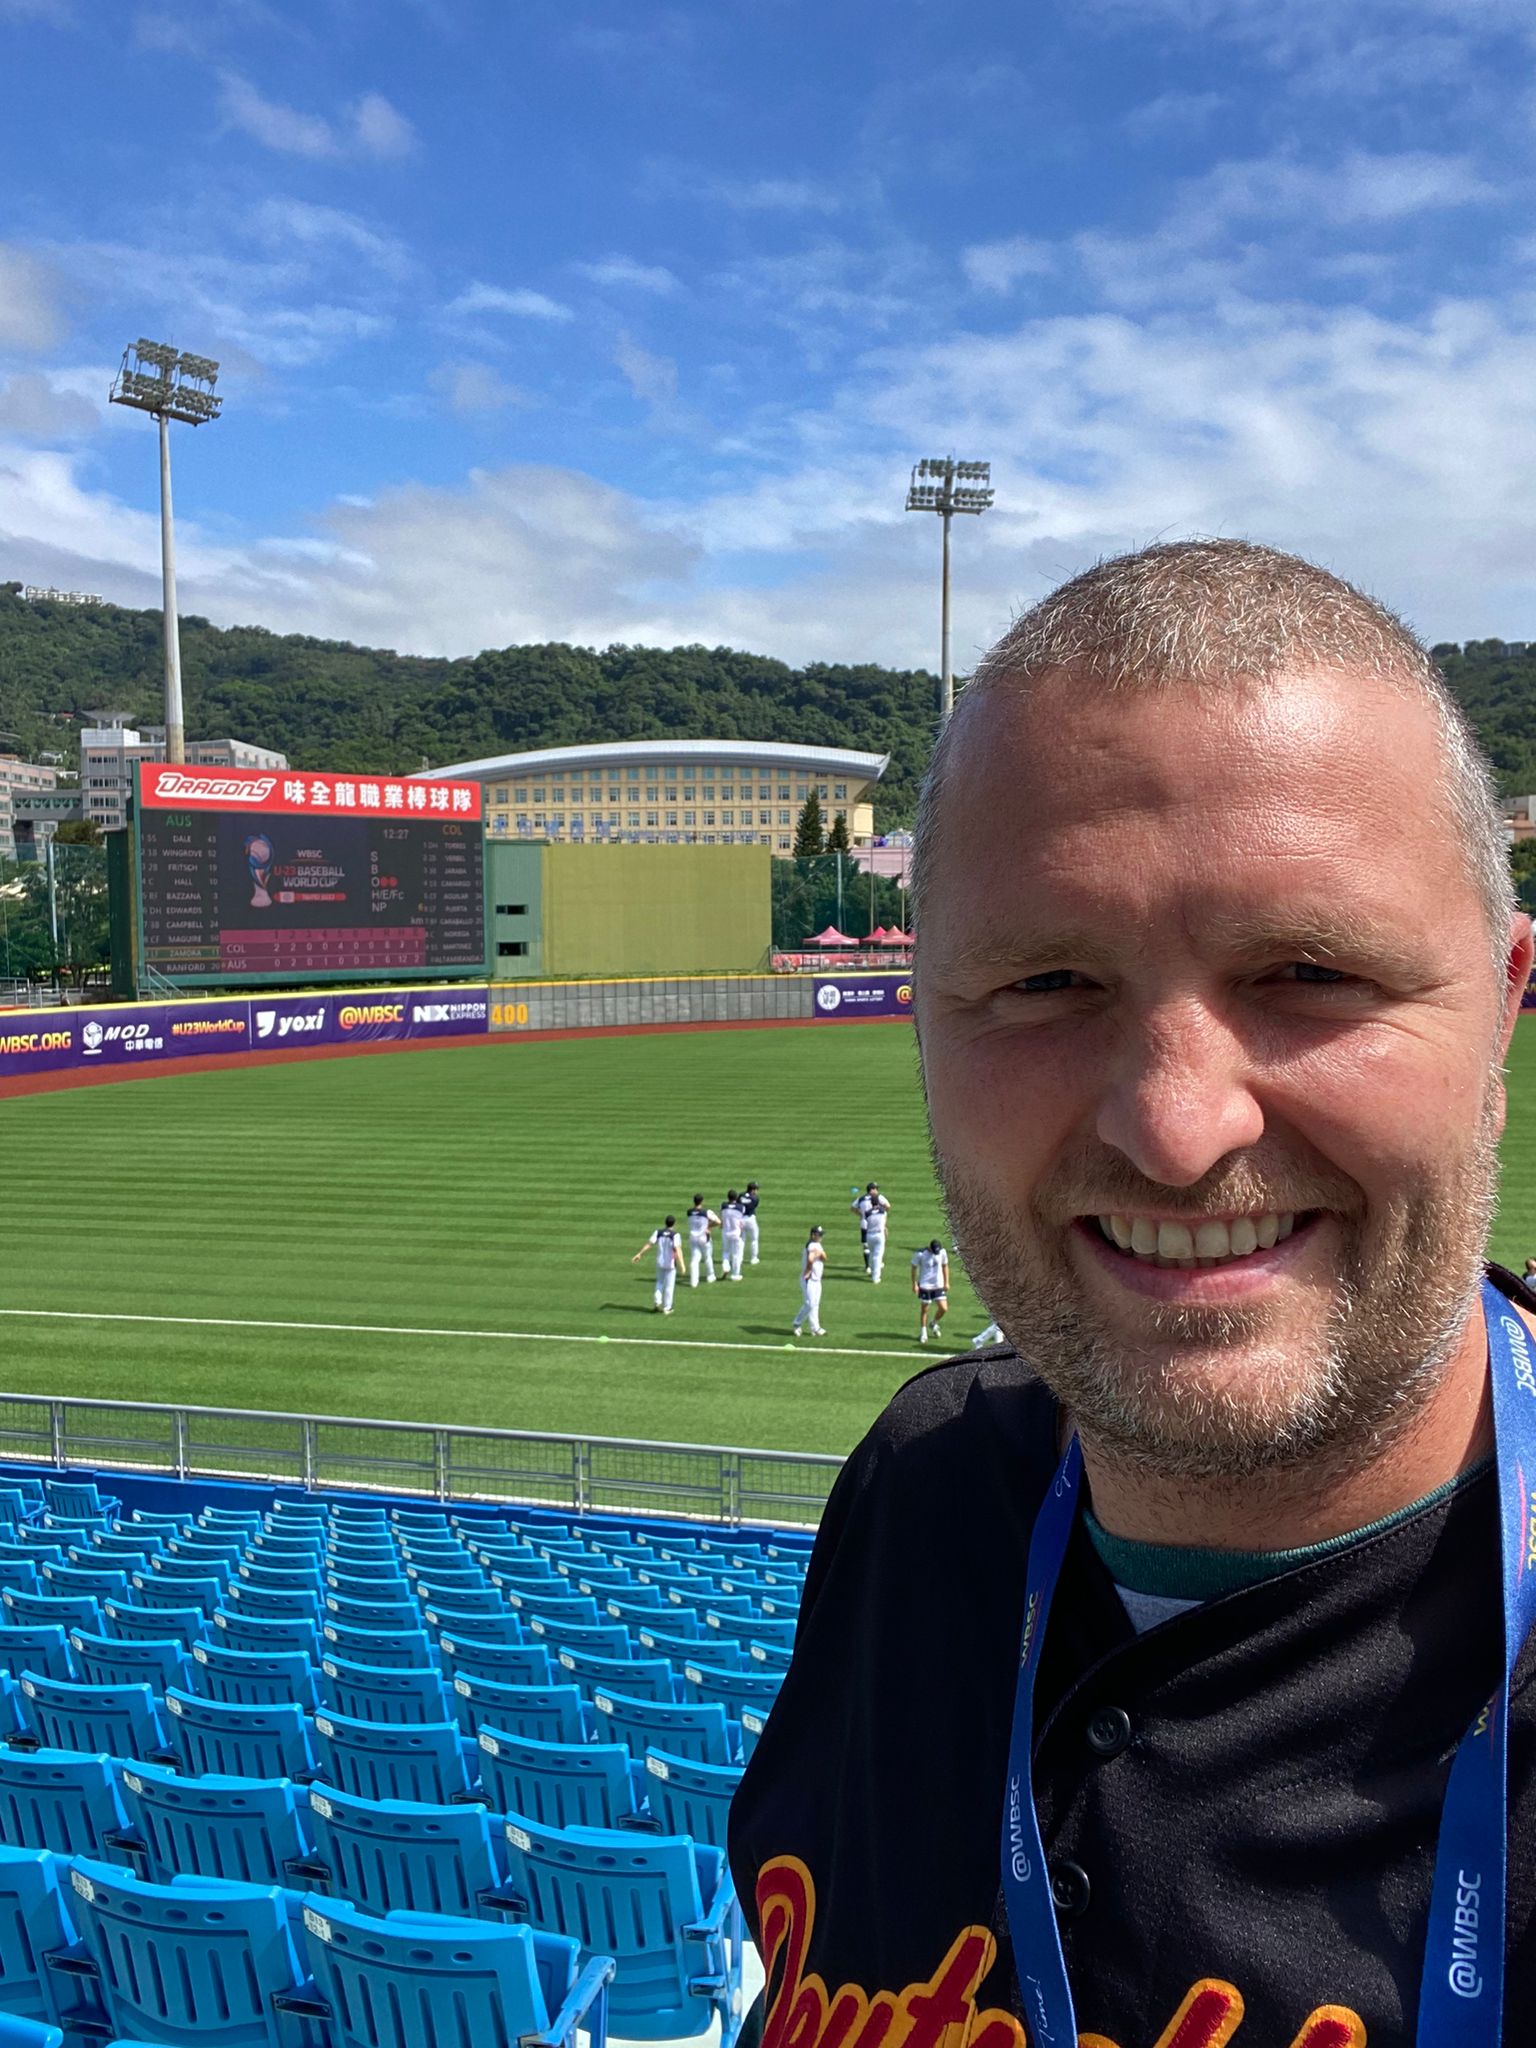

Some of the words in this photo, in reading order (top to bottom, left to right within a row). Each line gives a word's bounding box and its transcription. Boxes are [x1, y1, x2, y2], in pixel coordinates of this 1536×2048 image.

[156, 773, 276, 801] DRAGONS
[283, 780, 473, 812] 味全龍職業棒球隊
[166, 816, 192, 827] AUS
[383, 829, 409, 840] 12:27
[442, 825, 463, 836] COL
[173, 835, 191, 843] DALE
[297, 849, 322, 858] WBSC
[371, 851, 378, 862] S
[297, 866, 345, 876] BASEBALL
[371, 864, 378, 874] B
[174, 878, 193, 886] HALL
[283, 877, 318, 887] WORLD
[319, 878, 338, 887] CUP
[166, 892, 201, 900] BAZZANA
[371, 903, 387, 914] NP
[166, 921, 203, 929] CAMPBELL
[411, 917, 423, 925] km
[168, 935, 201, 943] MAGUIRE
[226, 944, 246, 954] COL
[274, 944, 280, 952] 2
[290, 943, 296, 951] 2
[322, 942, 328, 950] 0
[338, 941, 344, 950] 4
[167, 964, 205, 972] RANFORD
[227, 959, 247, 969] AUS
[274, 959, 280, 967] 0
[290, 958, 296, 966] 2
[450, 1003, 486, 1012] NIPPON
[339, 1005, 404, 1030] @WBSC
[450, 1011, 486, 1020] EXPRESS
[491, 1004, 528, 1025] 400
[278, 1008, 325, 1036] yoxi
[104, 1024, 150, 1041] MOD
[171, 1021, 245, 1036] #U23WorldCup
[125, 1037, 163, 1051] 中華電信
[1021, 1591, 1039, 1668] WBSC
[1010, 1774, 1031, 1882] @WBSC
[309, 1911, 324, 1927] B13
[1448, 1869, 1483, 1998] @WBSC
[1026, 1975, 1056, 2047] Time!
